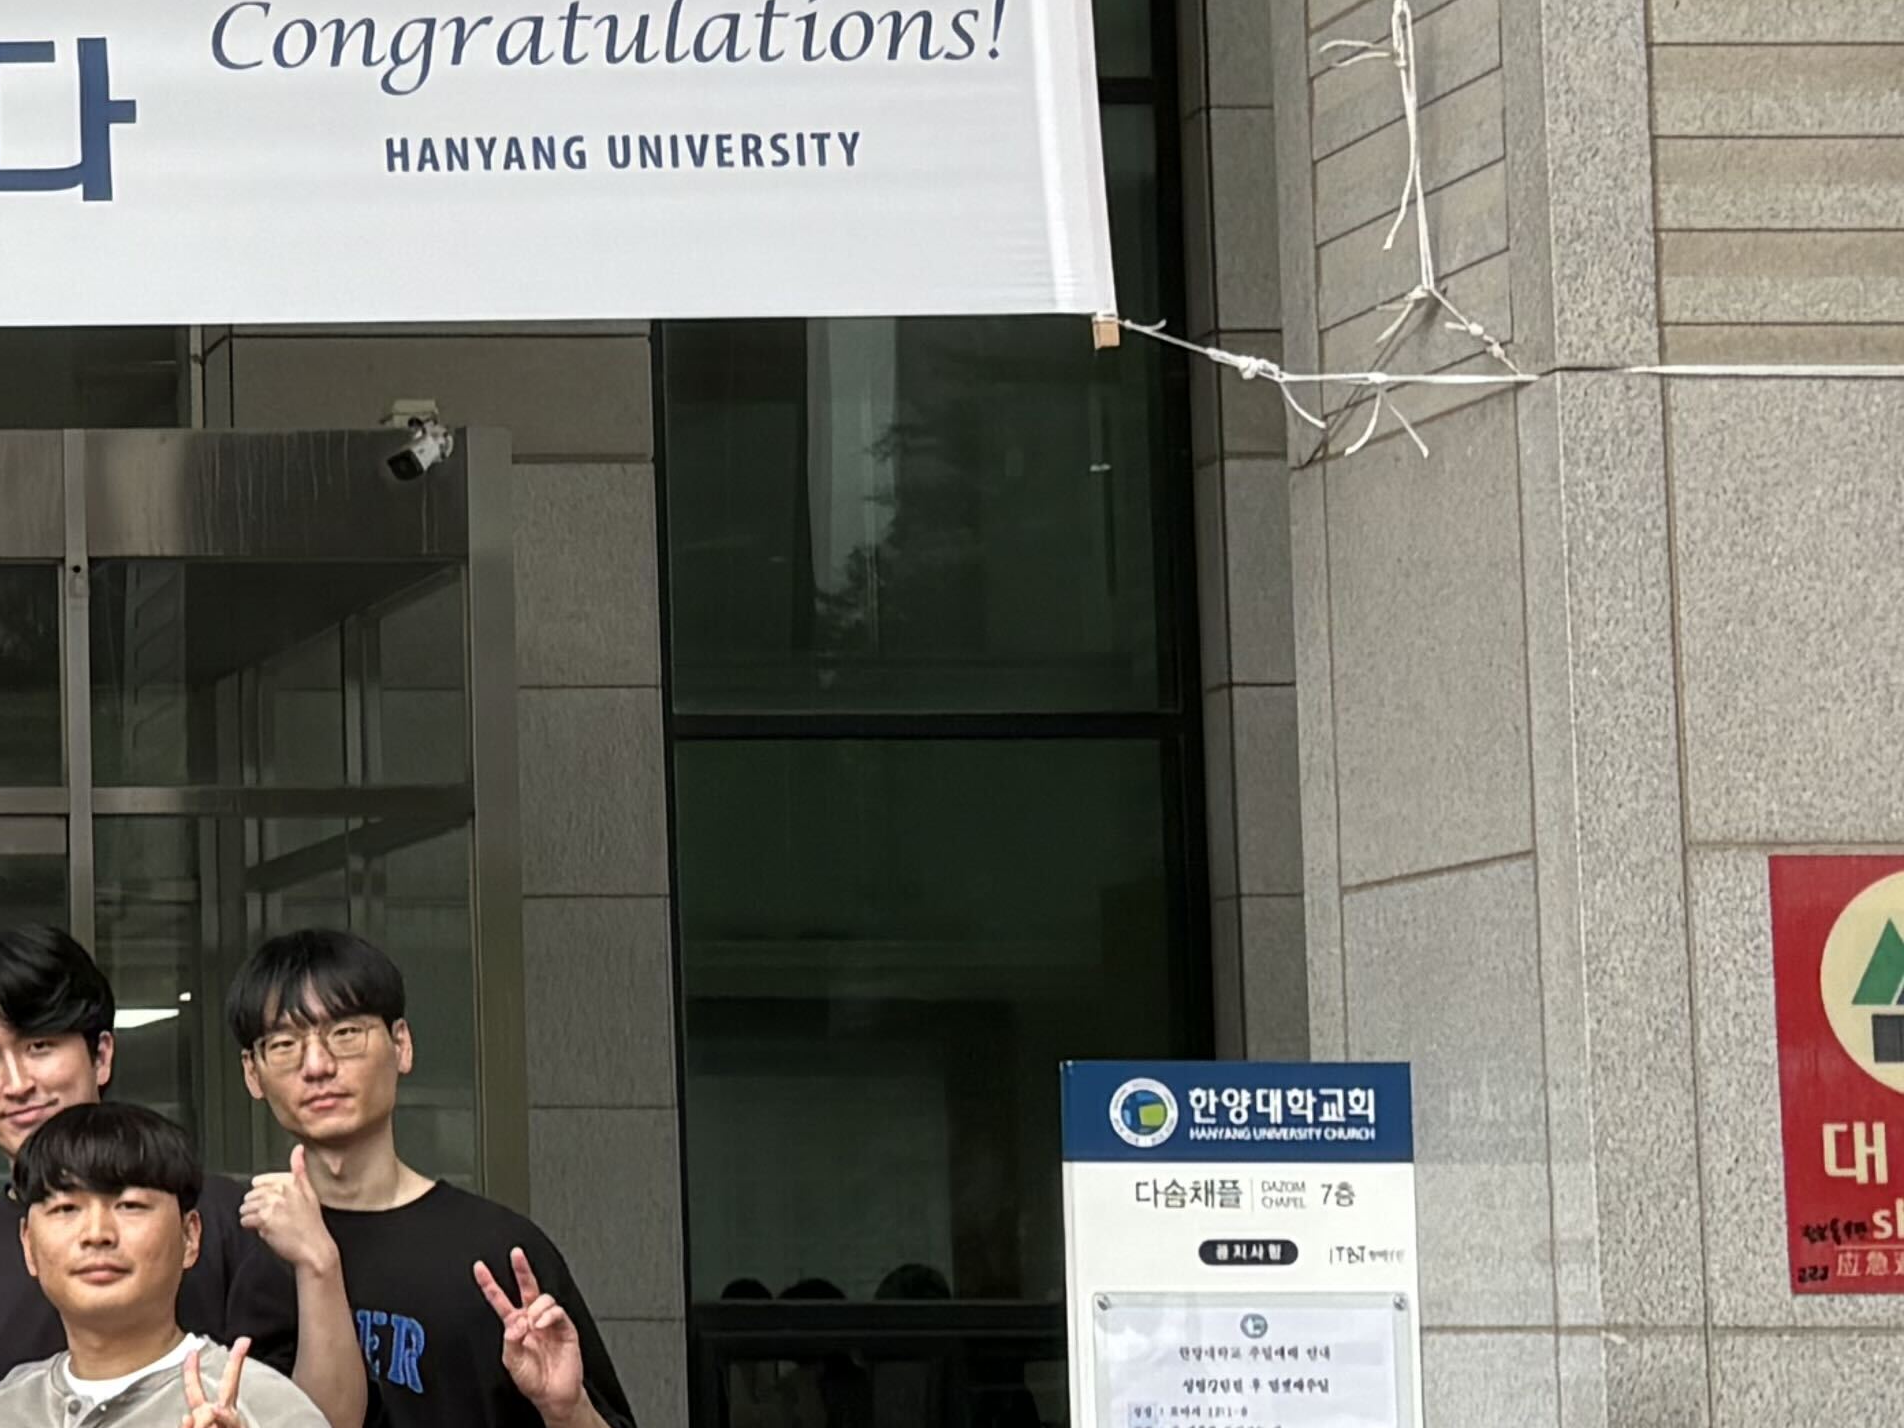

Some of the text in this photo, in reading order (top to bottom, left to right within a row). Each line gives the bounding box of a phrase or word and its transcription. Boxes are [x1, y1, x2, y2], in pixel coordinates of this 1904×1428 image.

[386, 132, 859, 172] HANYANG UNIVERSITY
[1188, 1087, 1376, 1124] 한양대학교회
[1190, 1126, 1376, 1141] HANYANG UNIVERSITY CHURCH
[1822, 1121, 1889, 1185] 대
[1135, 1178, 1242, 1209] 다솜채플
[1320, 1182, 1356, 1208] 7층
